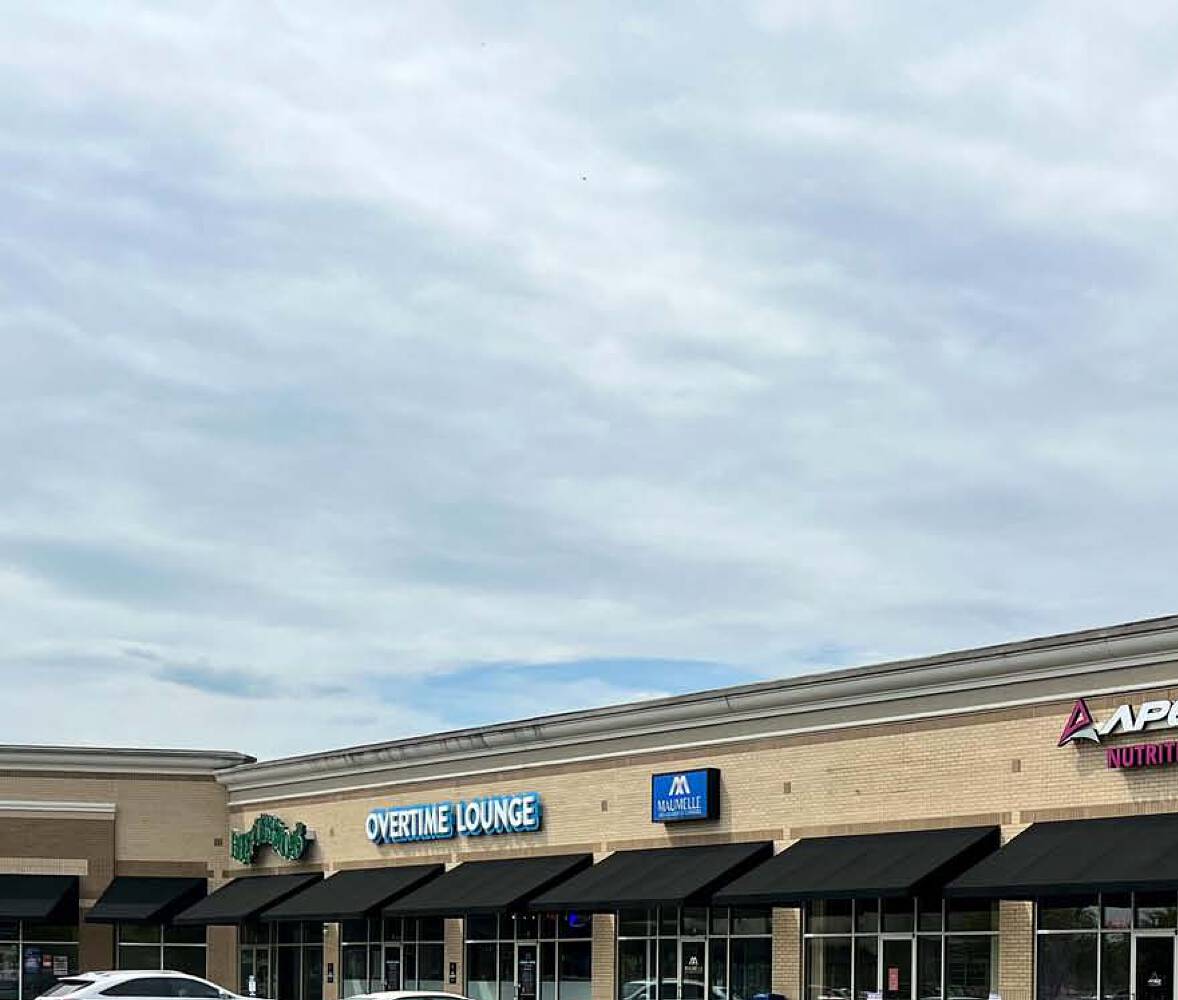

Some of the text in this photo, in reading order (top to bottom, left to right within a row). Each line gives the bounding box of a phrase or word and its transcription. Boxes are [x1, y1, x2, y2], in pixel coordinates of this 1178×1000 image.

[366, 795, 537, 841] OVERTIME LOUNGE
[657, 796, 702, 812] MAUMELLE
